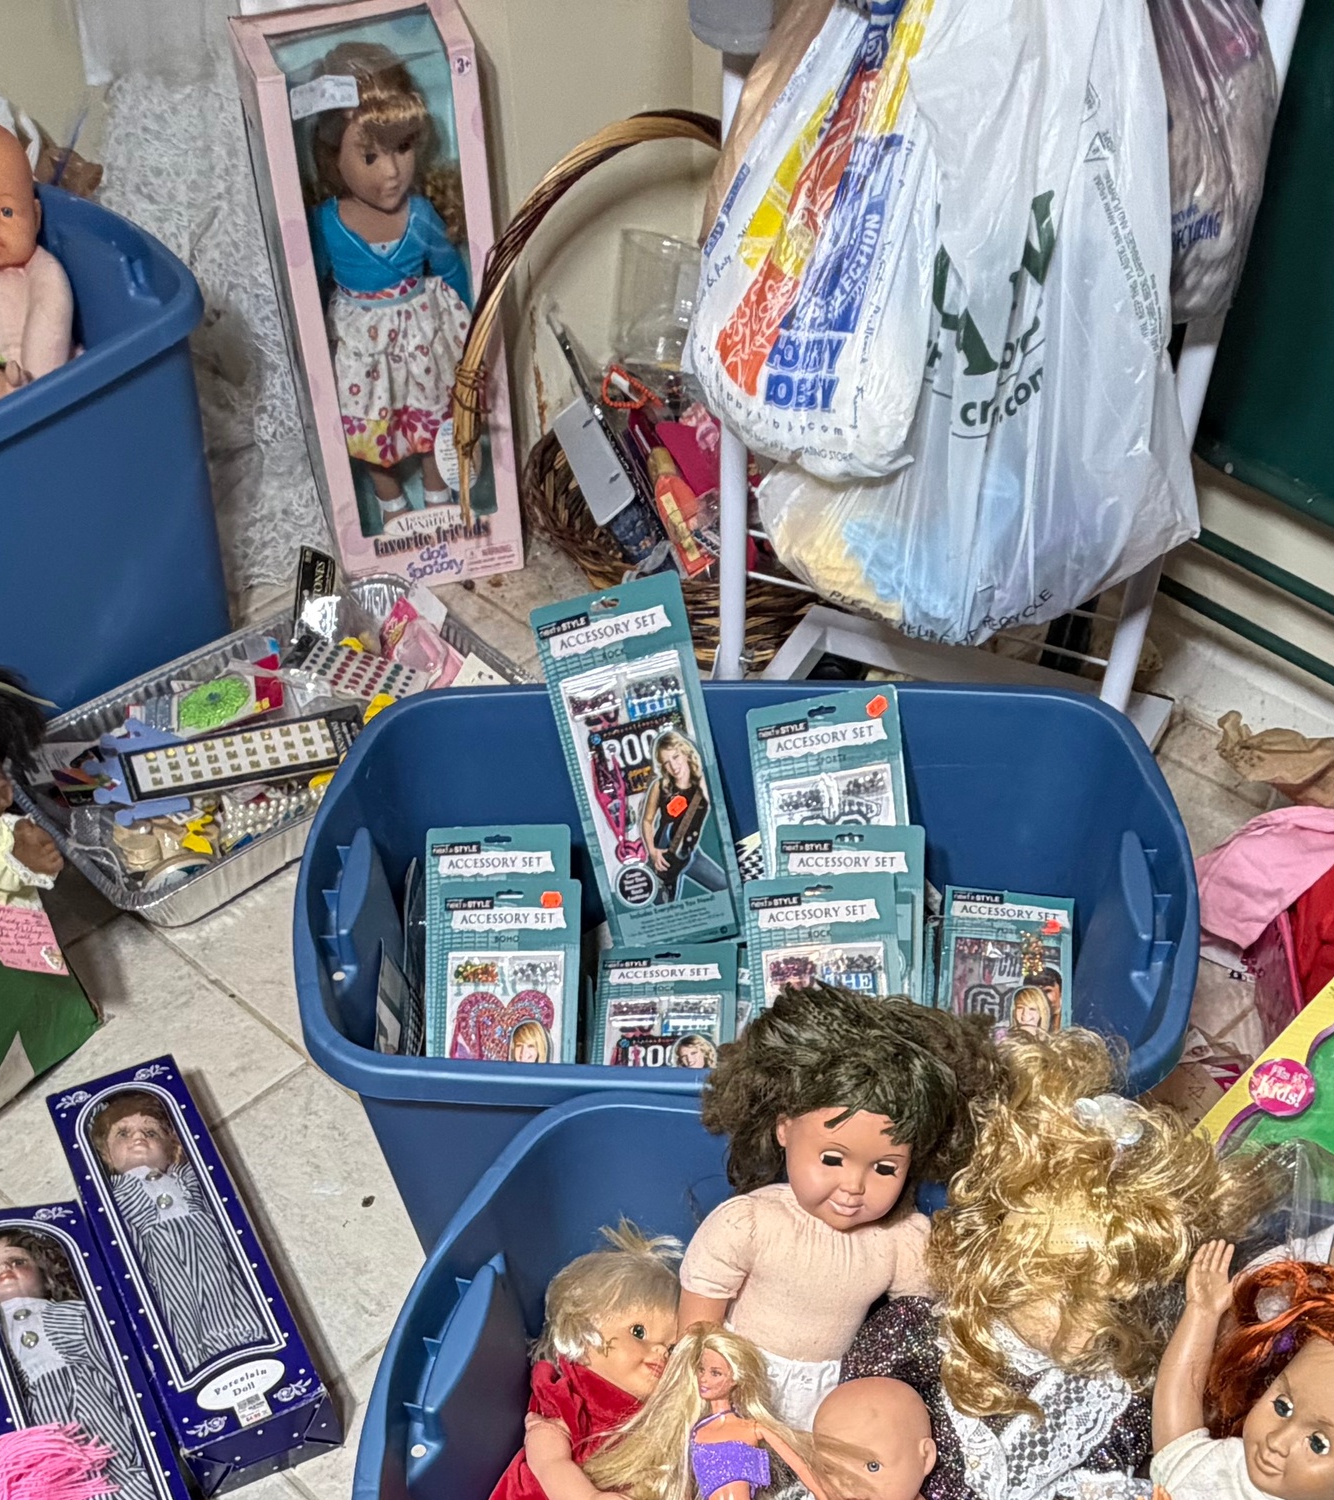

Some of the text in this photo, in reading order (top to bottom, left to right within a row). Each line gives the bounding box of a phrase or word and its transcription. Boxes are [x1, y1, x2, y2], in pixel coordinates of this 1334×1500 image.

[397, 510, 465, 533] Alexande
[374, 530, 432, 556] favorite
[420, 544, 448, 562] doll
[559, 613, 657, 650] ACCESSORY SET
[776, 725, 874, 753] ACCESSORY SET
[447, 856, 544, 869] ACCESSORY SET
[797, 856, 897, 868] ACCESSORY SET
[460, 912, 557, 926] ACCESSORY SET
[768, 904, 867, 923] ACCESSORY SET
[960, 904, 1060, 922] ACCESSORY SET
[617, 967, 710, 980] ACCESSORY SET
[214, 1368, 267, 1395] Porcelain
[232, 1382, 256, 1396] Doll
